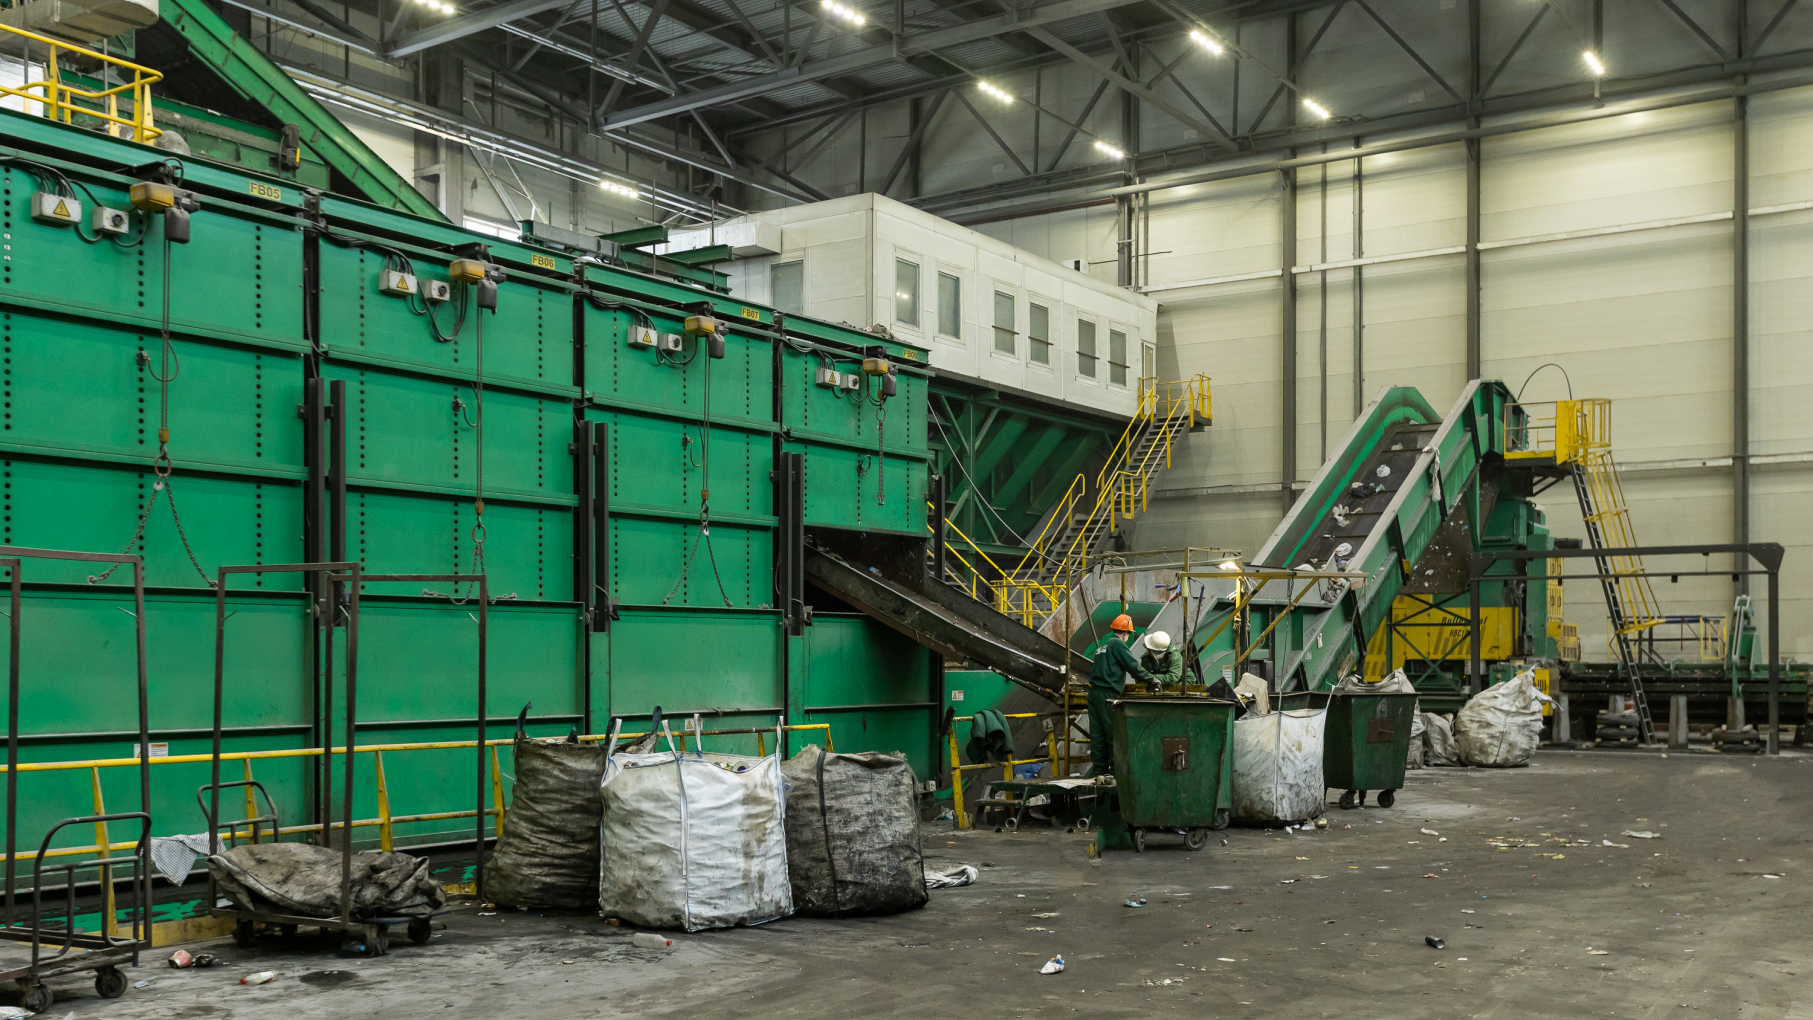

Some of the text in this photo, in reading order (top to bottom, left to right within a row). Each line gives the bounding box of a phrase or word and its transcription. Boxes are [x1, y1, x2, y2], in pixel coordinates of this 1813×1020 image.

[250, 181, 280, 200] FB05
[532, 254, 554, 269] FB06
[742, 307, 759, 320] FB07
